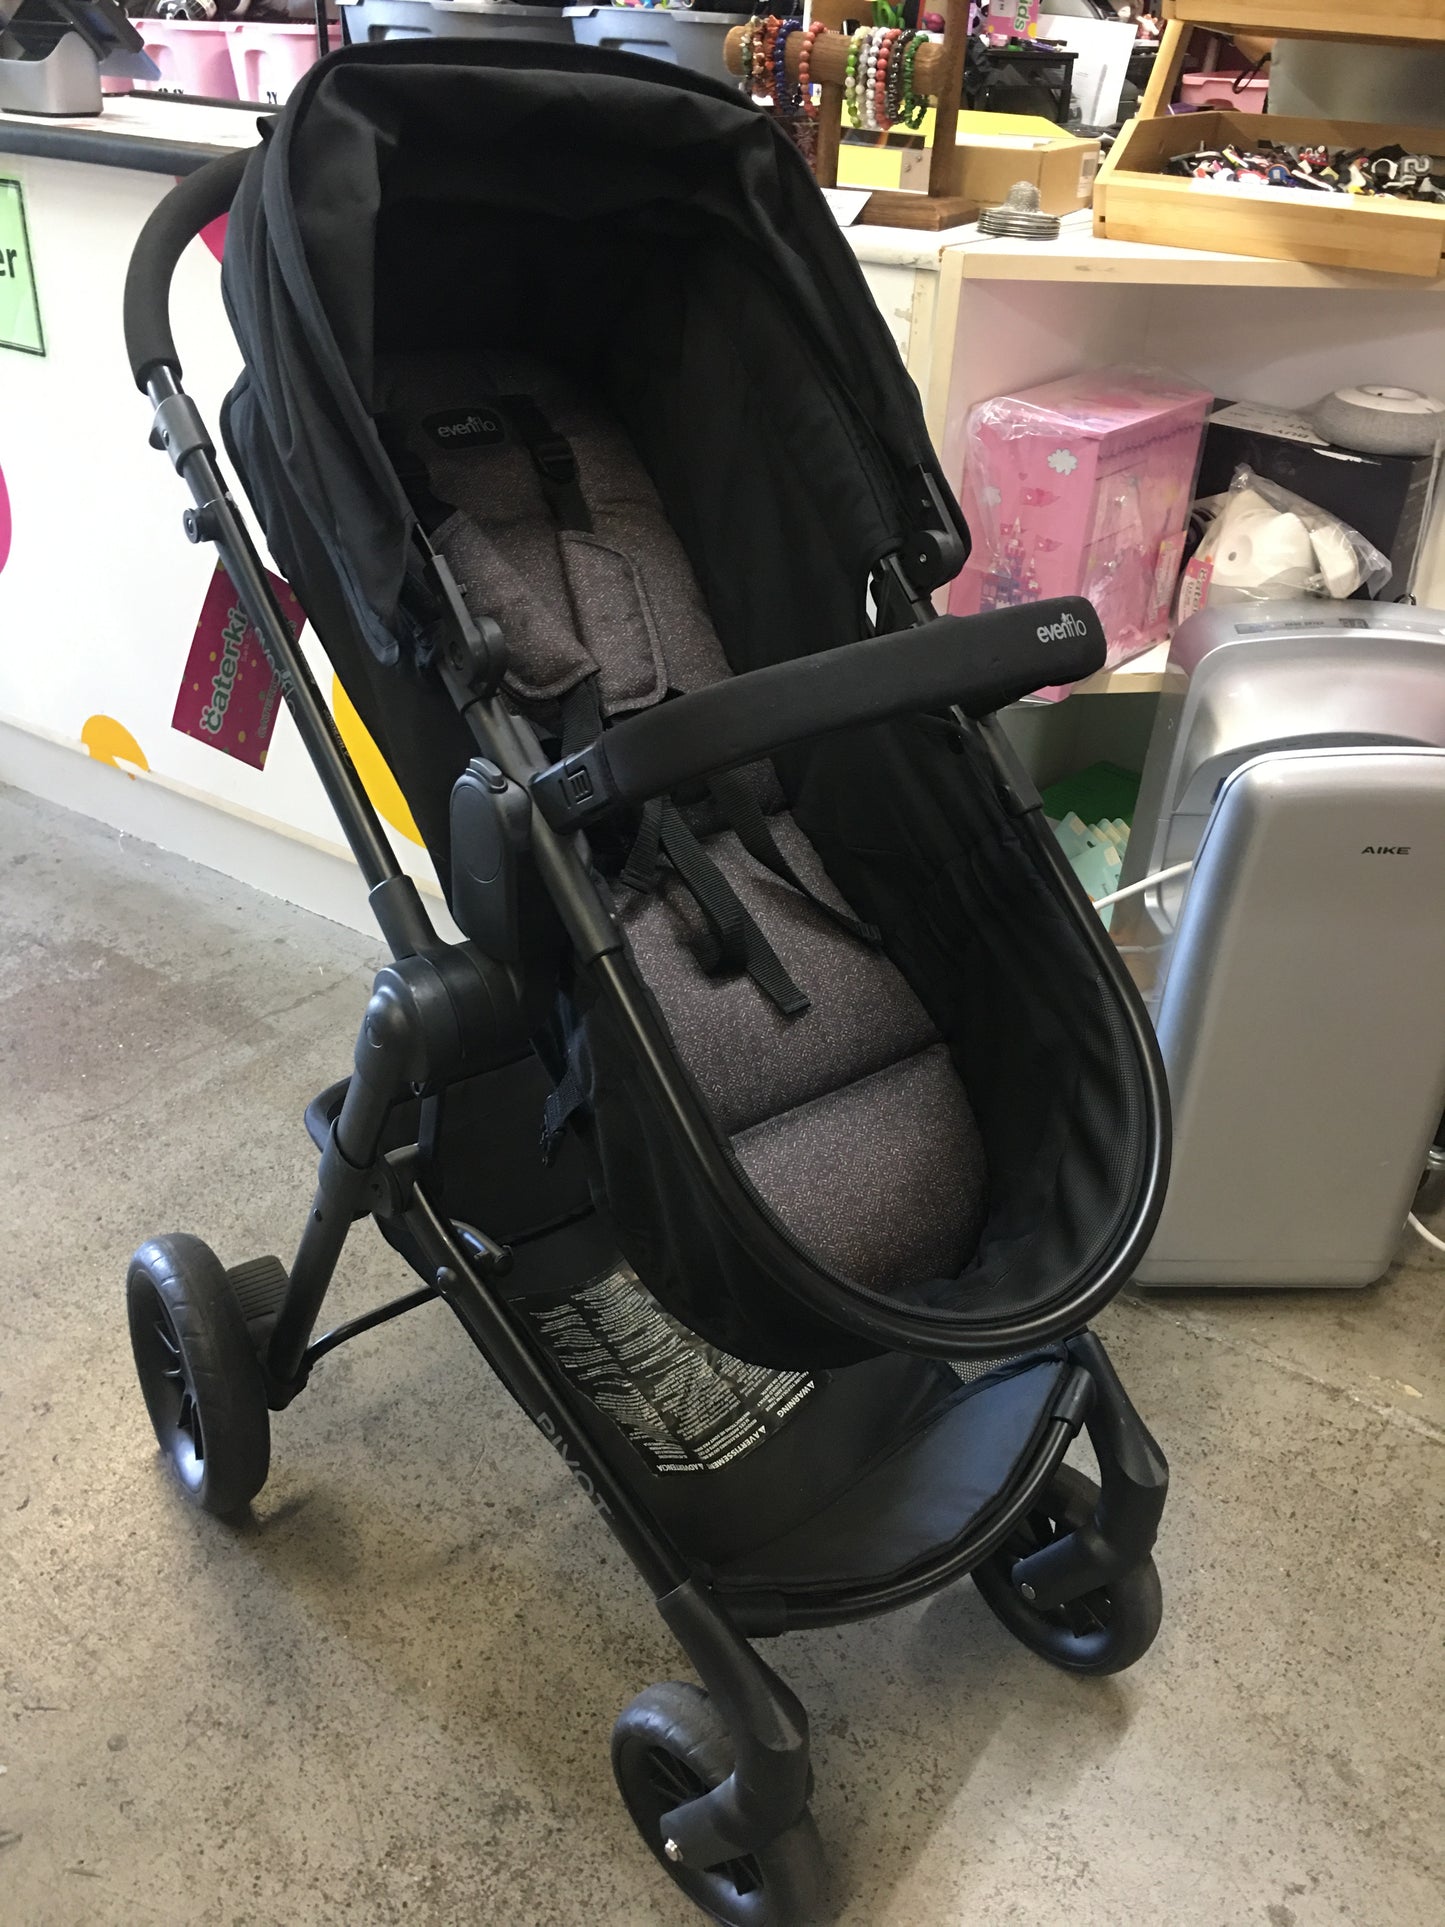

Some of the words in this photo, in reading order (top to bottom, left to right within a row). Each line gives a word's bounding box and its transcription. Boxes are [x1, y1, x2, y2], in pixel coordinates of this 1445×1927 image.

[438, 416, 497, 438] evenflo
[1036, 612, 1087, 643] evenflo
[1361, 846, 1411, 855] AIKE
[776, 1386, 810, 1418] WARNING
[537, 1412, 612, 1515] PIVOT
